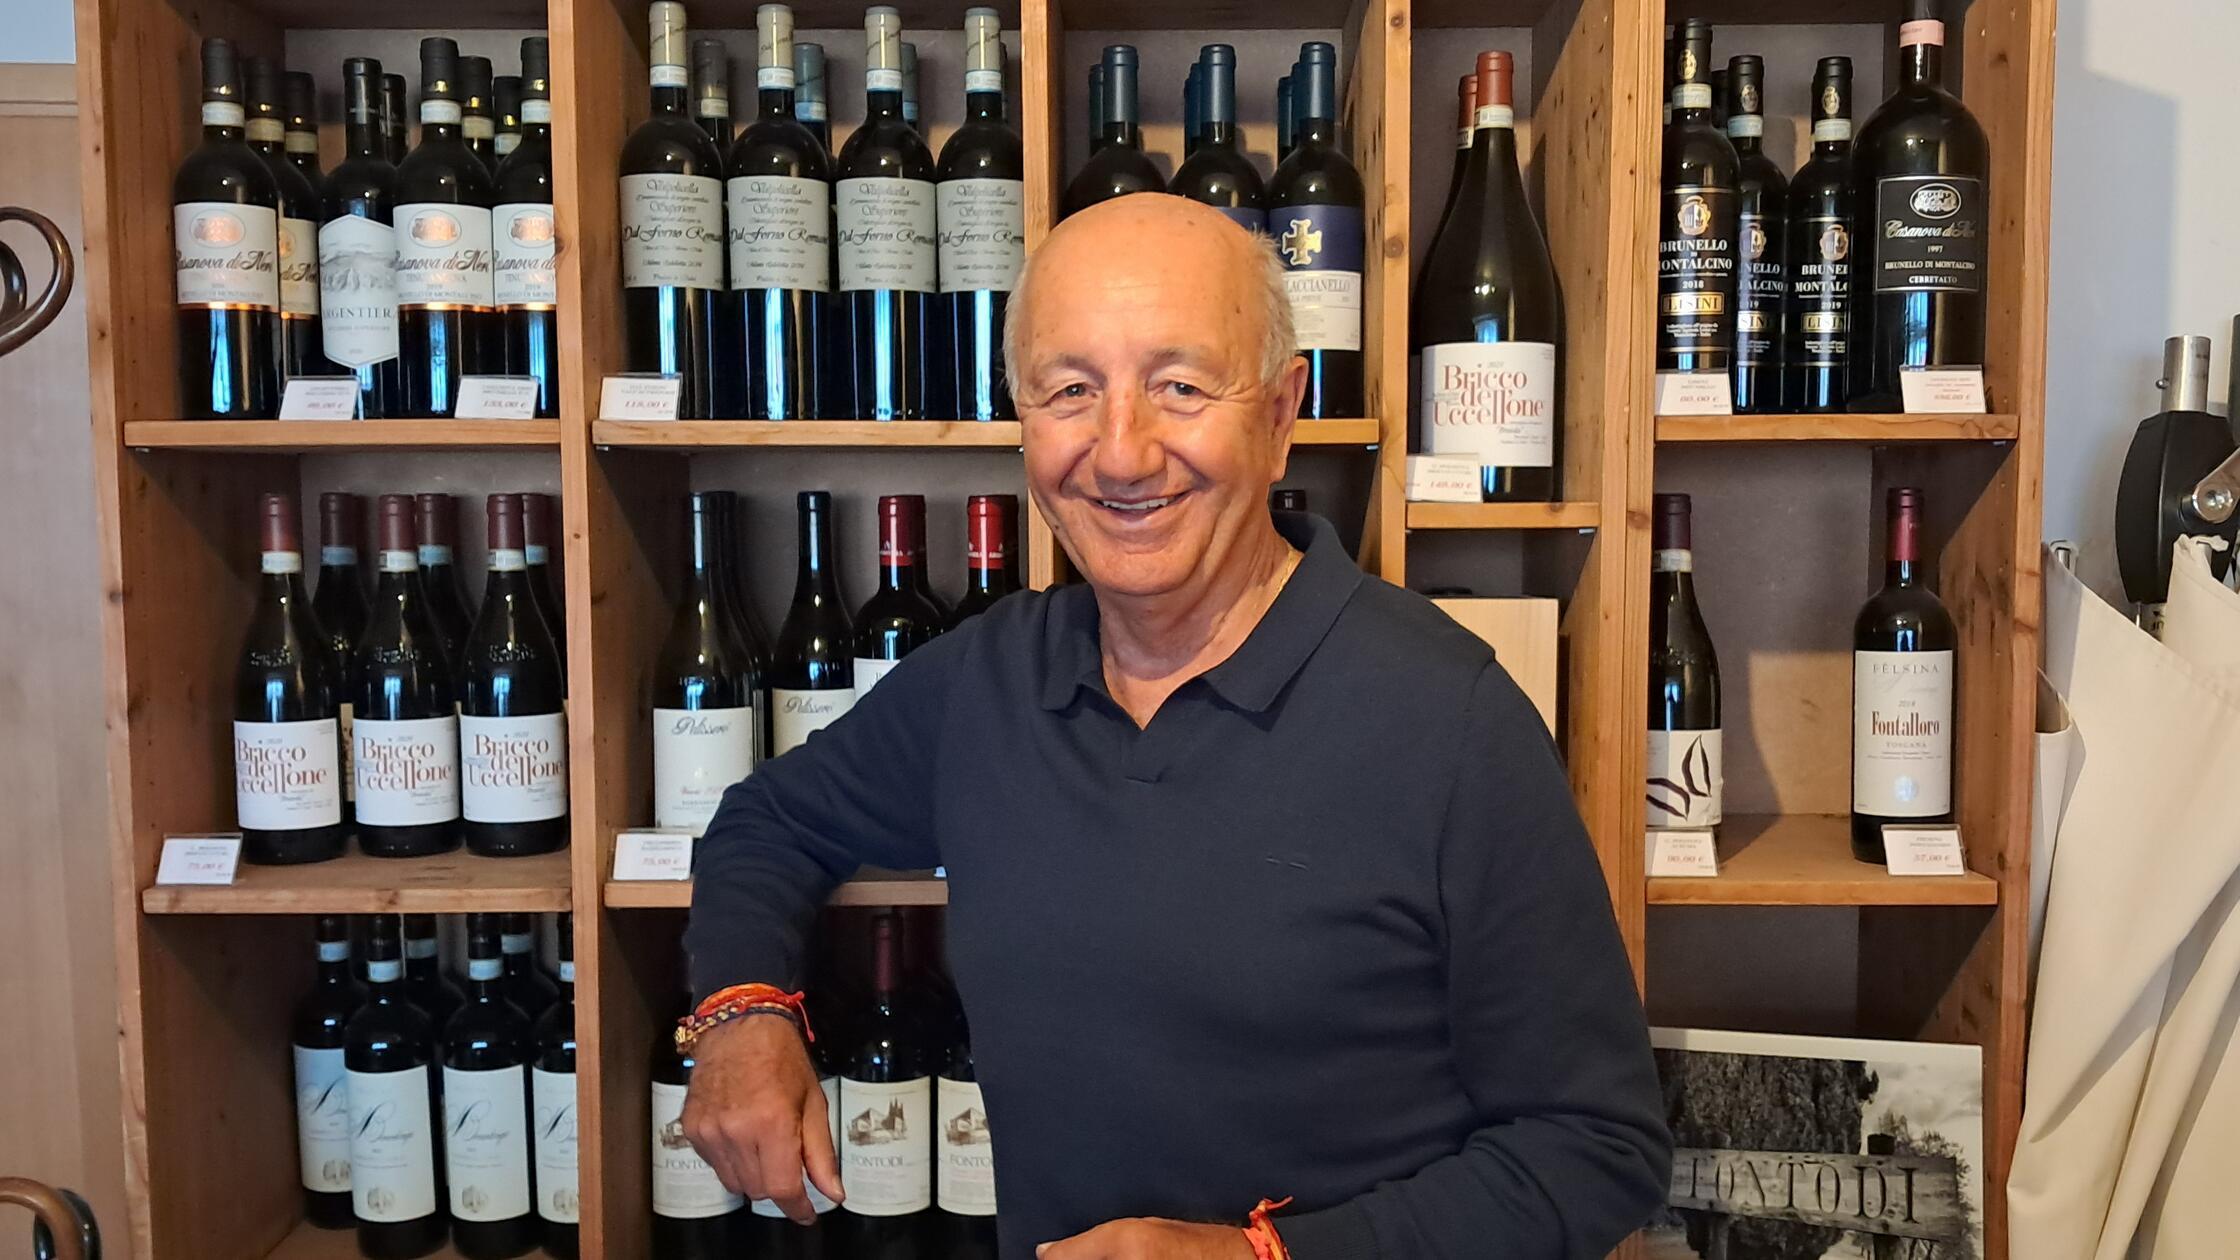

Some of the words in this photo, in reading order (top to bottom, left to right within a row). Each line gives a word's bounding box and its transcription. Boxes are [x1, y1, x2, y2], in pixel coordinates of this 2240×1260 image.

[1884, 219, 1943, 239] Casanova
[1660, 239, 1729, 253] BRUNELLO
[1658, 258, 1733, 271] ONTALCINO
[1744, 263, 1781, 275] NELLO
[1884, 261, 1924, 271] BRUNELLO
[1925, 261, 1934, 269] DI
[1935, 261, 1976, 270] MONTALCINO
[1286, 278, 1350, 293] LACCIANELLO
[1908, 275, 1958, 284] CERRETALTO
[1668, 296, 1718, 311] LISINI
[1444, 363, 1528, 391] Bricco
[1871, 711, 1940, 737] Fontalloro
[236, 738, 306, 762] Bricco
[361, 735, 435, 760] Bricco
[474, 733, 550, 757] Bricco
[238, 767, 327, 795] ccellone
[664, 1158, 709, 1170] FONTO
[851, 1154, 904, 1168] FONTODI
[950, 1154, 992, 1168] FONTO
